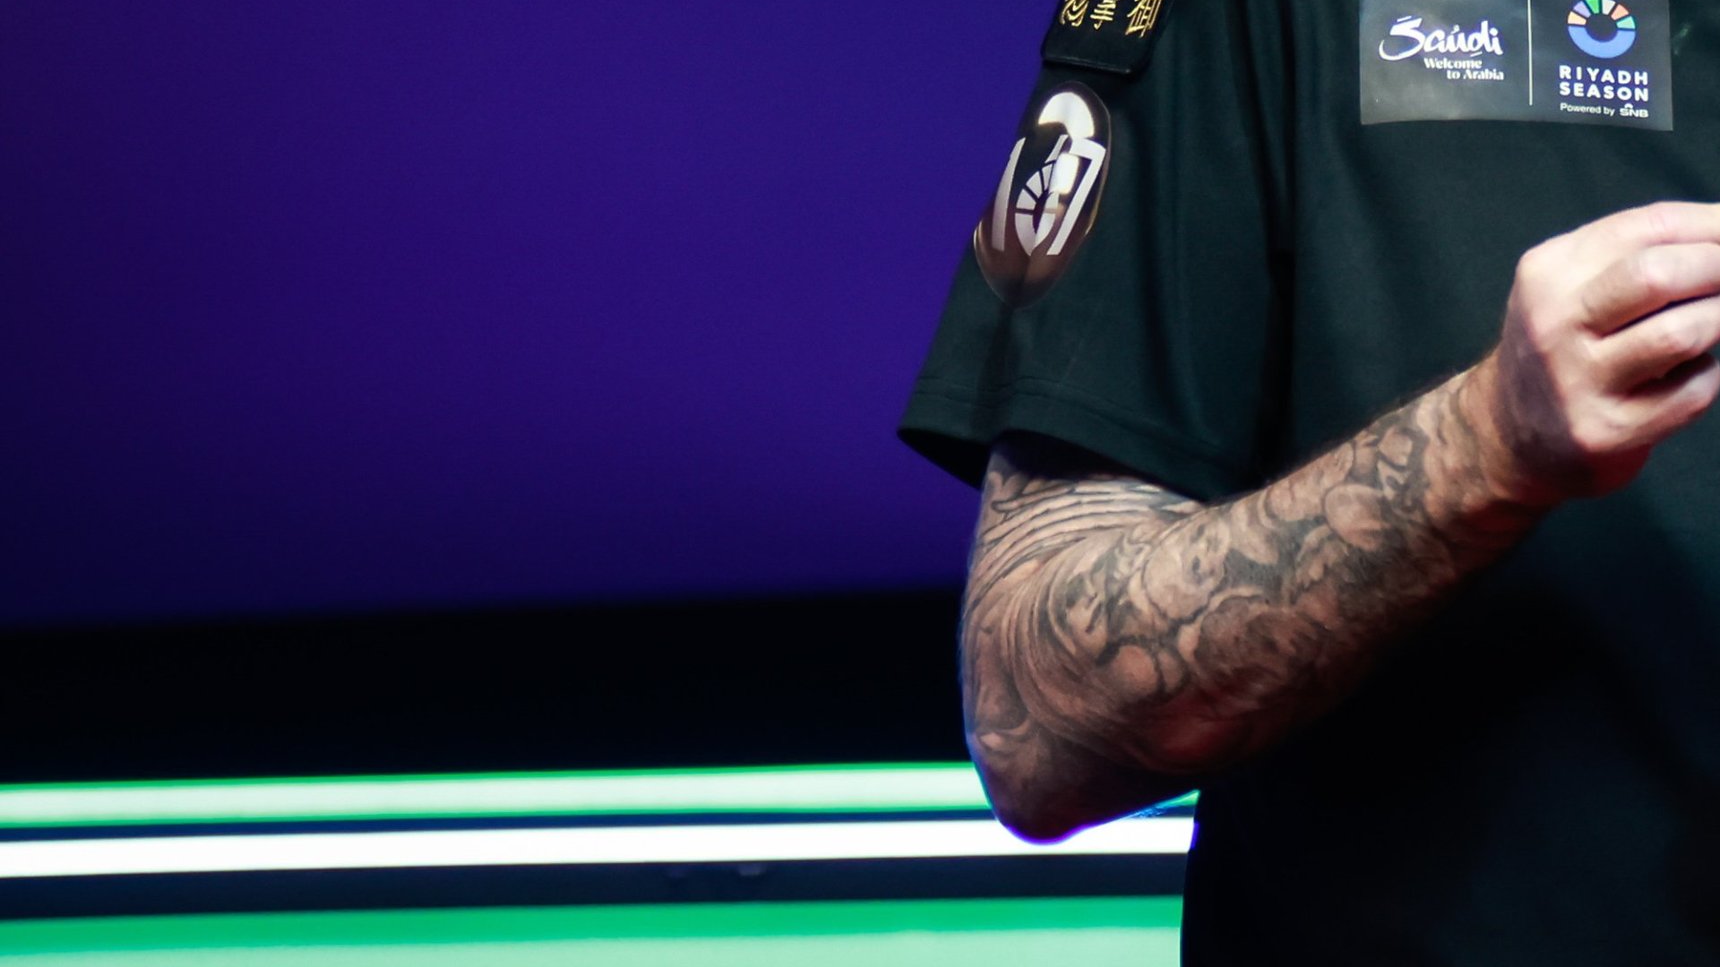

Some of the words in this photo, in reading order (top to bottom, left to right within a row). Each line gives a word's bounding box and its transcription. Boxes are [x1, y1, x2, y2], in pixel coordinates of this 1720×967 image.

[1379, 16, 1503, 61] Saudi
[1423, 57, 1482, 69] Welcome
[1446, 68, 1460, 80] to
[1463, 68, 1504, 81] Arabia
[1559, 65, 1649, 85] RIYADH
[1559, 82, 1649, 101] SEASON
[1560, 102, 1601, 114] Powered
[1603, 106, 1615, 117] by
[1619, 107, 1649, 118] SNB
